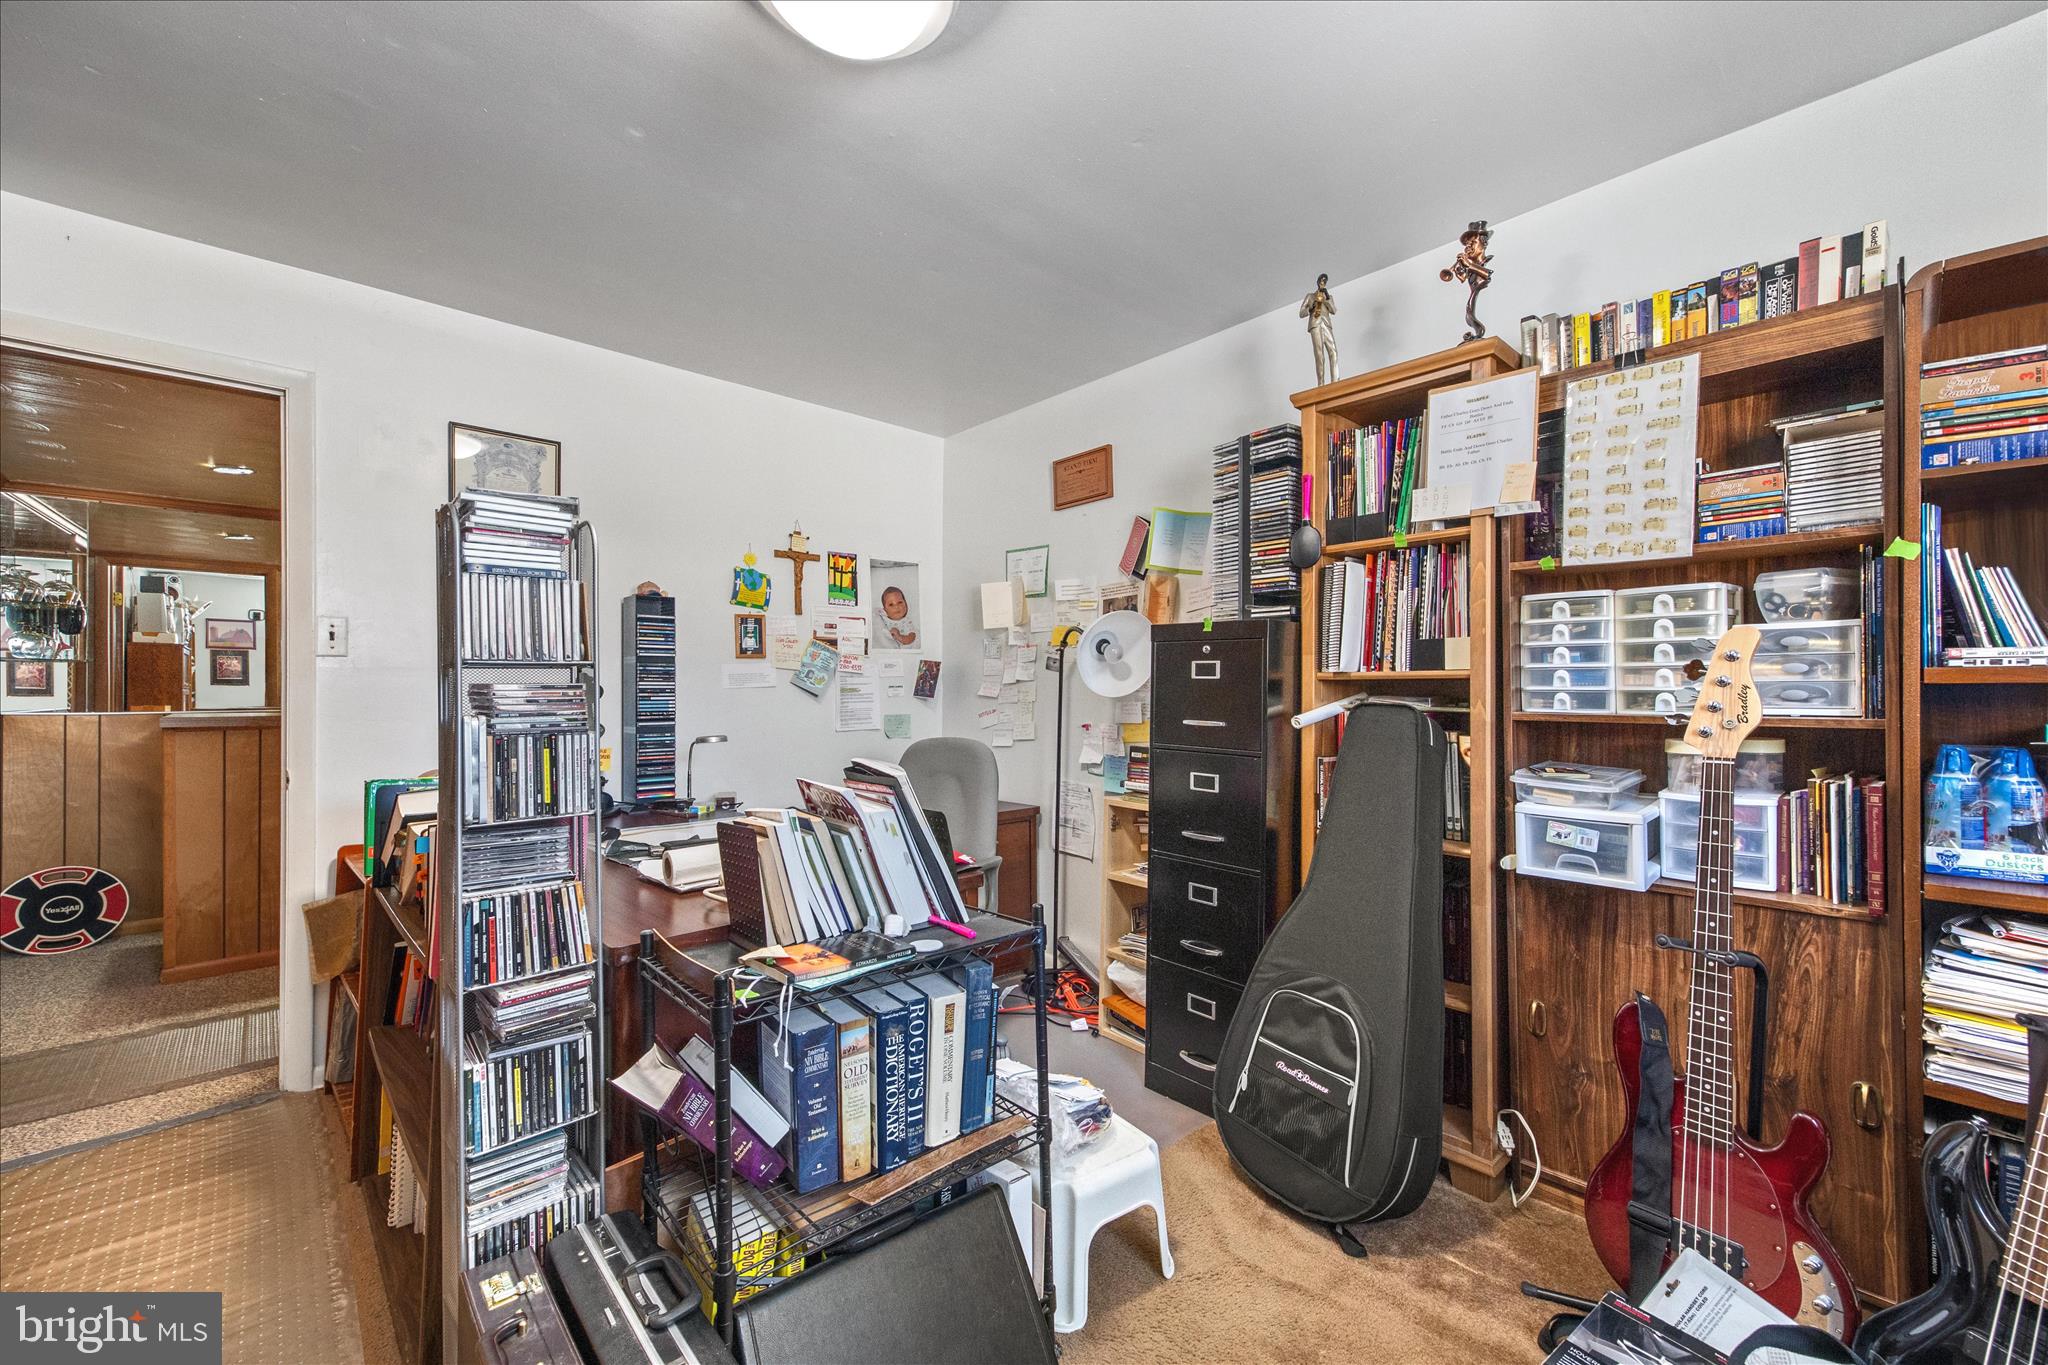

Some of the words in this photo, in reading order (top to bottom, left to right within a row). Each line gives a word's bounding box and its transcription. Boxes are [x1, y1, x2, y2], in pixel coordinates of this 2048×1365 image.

[1737, 684, 1751, 724] Bradley
[799, 779, 852, 809] Amazon
[1985, 858, 2045, 872] Dusters
[2014, 854, 2044, 863] Pack
[855, 957, 879, 968] EDWARDS
[886, 1034, 904, 1046] THE
[908, 1001, 926, 1100] ROGET'S
[804, 1056, 813, 1068] NIV
[813, 1053, 829, 1067] BIBLE
[804, 1061, 829, 1074] COMMENTARY
[843, 1057, 868, 1068] NELSON'S
[897, 1043, 906, 1091] AMERICAN
[844, 1063, 868, 1080] OLD
[1275, 1060, 1297, 1077] Road
[1302, 1073, 1329, 1094] Runner
[843, 1079, 868, 1091] SURVEY
[691, 1092, 705, 1110] BIBLE
[808, 1097, 822, 1105] Volume
[885, 1045, 900, 1143] DICTIONARY
[689, 1099, 710, 1127] COMMENTARY
[808, 1106, 828, 1117] Testament
[813, 1102, 822, 1110] Old
[898, 1091, 906, 1140] HERITAGE
[907, 1105, 923, 1124] II
[1683, 1297, 1700, 1316] HANDSET
[1696, 1296, 1709, 1312] COILED
